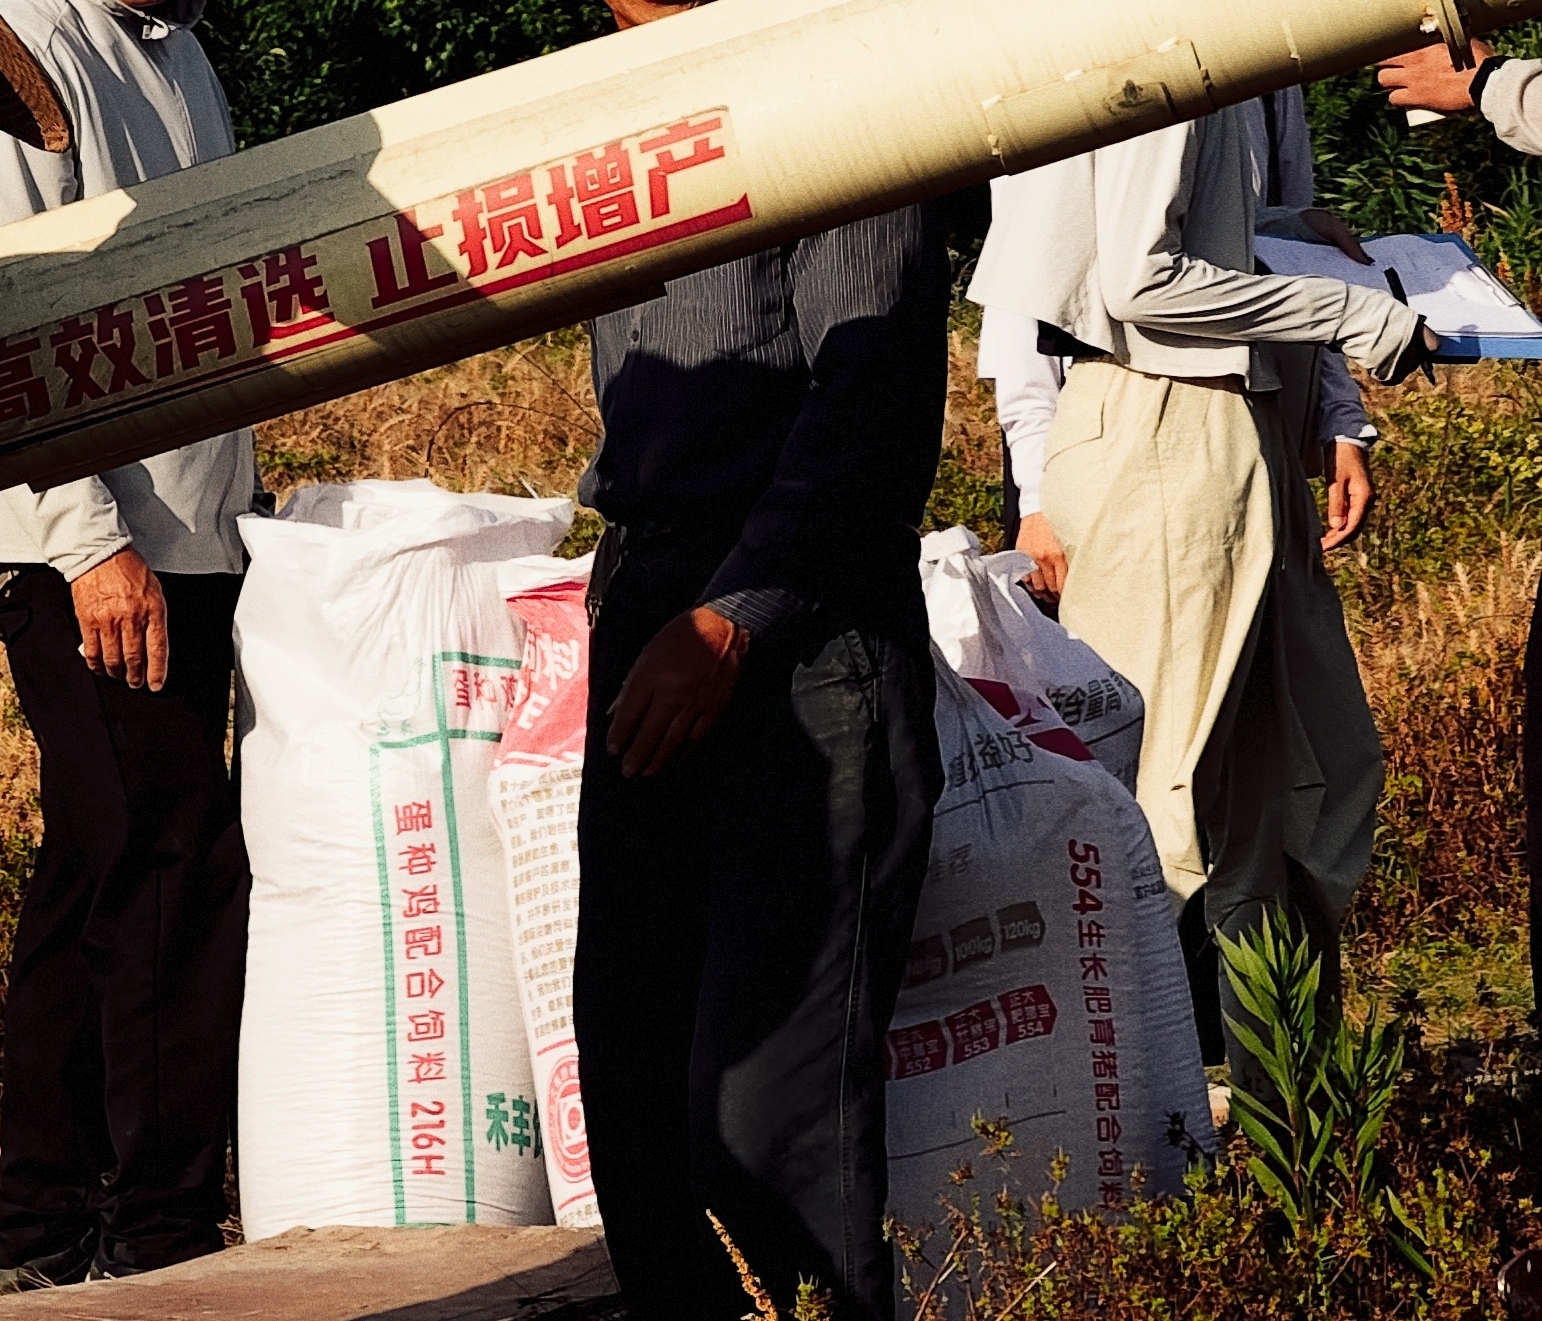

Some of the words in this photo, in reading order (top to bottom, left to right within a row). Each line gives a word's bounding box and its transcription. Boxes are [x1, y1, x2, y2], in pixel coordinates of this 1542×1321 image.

[364, 116, 729, 310] 止损增产
[393, 799, 447, 1085] 蛋种鸡配合饲料
[1001, 919, 1041, 942] 120kg
[953, 934, 996, 962] 100kg
[1017, 1023, 1045, 1039] 554
[963, 1037, 992, 1058] 553
[904, 1057, 933, 1075] 552
[410, 1099, 446, 1177] 216H
